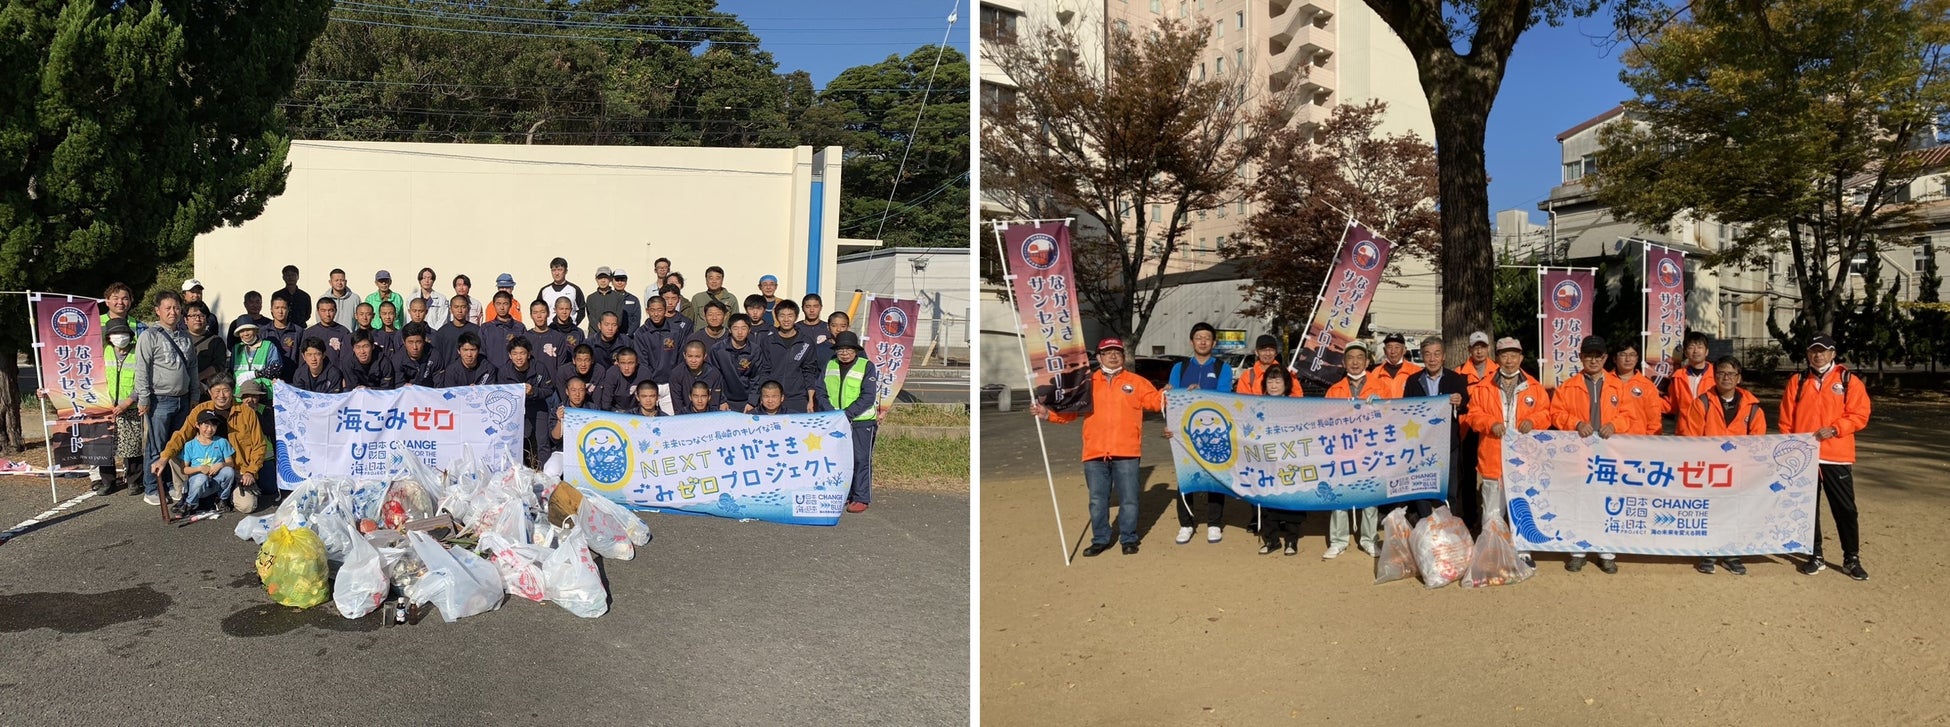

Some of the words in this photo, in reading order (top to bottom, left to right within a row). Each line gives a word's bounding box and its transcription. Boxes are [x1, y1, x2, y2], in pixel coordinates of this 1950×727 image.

[1049, 275, 1072, 341] ながさき
[1311, 269, 1355, 372] サンセットロード
[1340, 276, 1368, 328] ながさき
[1028, 276, 1065, 402] サンセットロード
[75, 345, 97, 404] ながさき
[883, 343, 904, 398] ながさき
[335, 406, 454, 433] 海ごみゼロ
[640, 451, 711, 479] NEXT
[717, 436, 799, 466] ながさき
[1239, 444, 1431, 488] ごみゼロプロジェクト
[1243, 438, 1313, 463] NEXT
[1318, 424, 1396, 455] ながさき
[633, 456, 837, 503] ごみゼロプロジェクト
[1586, 455, 1733, 489] 海ごみゼロ
[1652, 498, 1709, 509] CHANGE
[1677, 518, 1708, 529] BLUE
